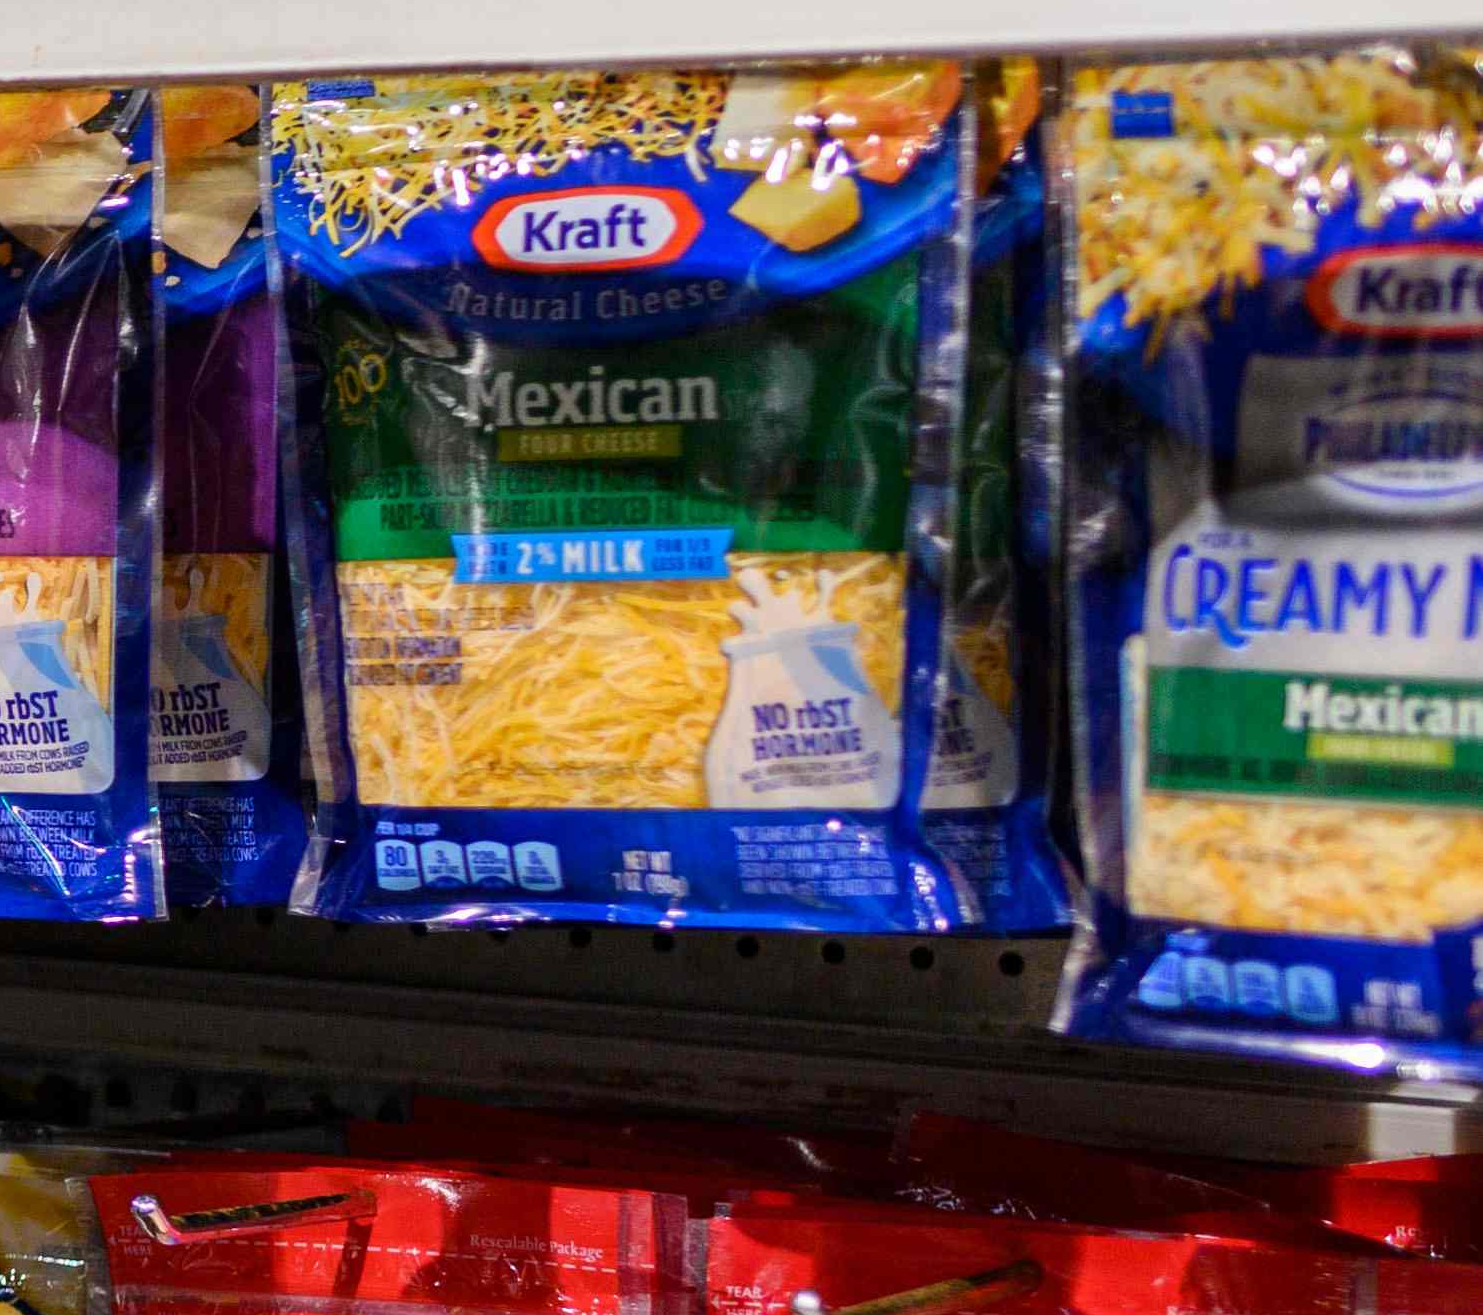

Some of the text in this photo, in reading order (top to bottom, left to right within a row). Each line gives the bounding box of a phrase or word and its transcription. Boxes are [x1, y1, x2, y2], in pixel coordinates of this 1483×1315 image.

[521, 202, 649, 255] Kraft
[461, 370, 720, 434] Mexican
[561, 538, 645, 576] MILK
[1162, 542, 1446, 650] CREAMY
[6, 690, 59, 721] rbST
[1283, 680, 1483, 738] Mexican
